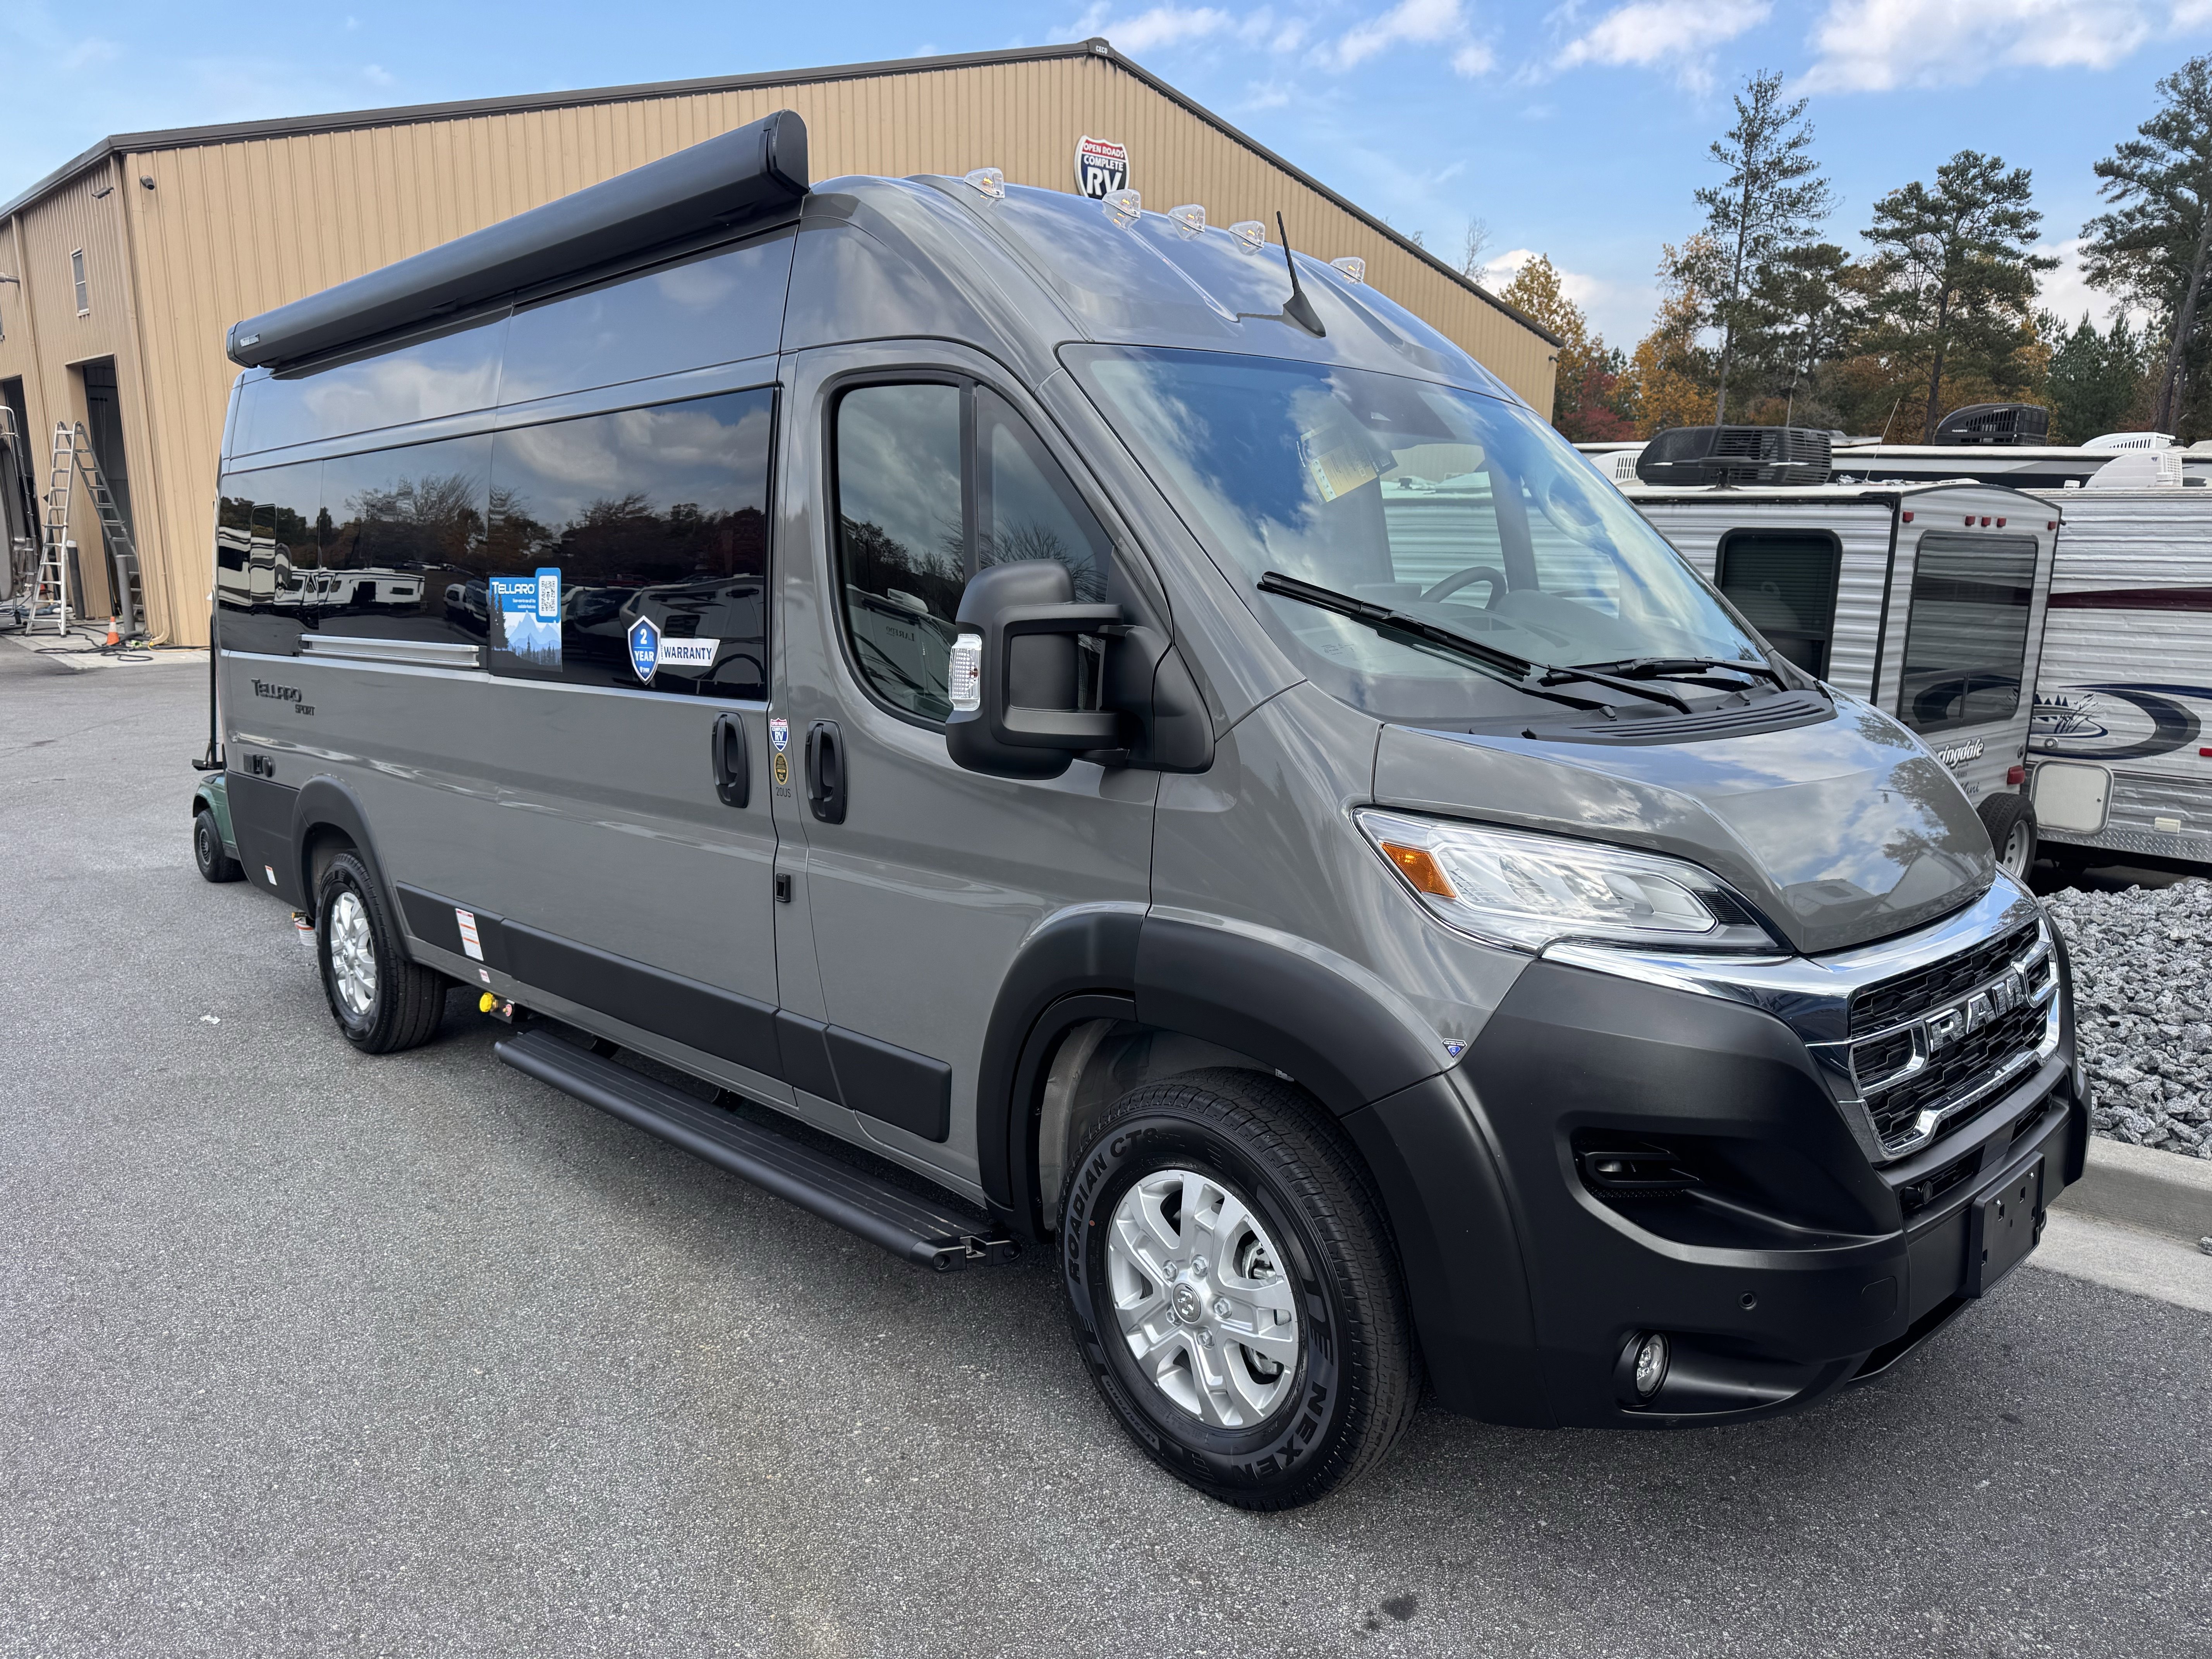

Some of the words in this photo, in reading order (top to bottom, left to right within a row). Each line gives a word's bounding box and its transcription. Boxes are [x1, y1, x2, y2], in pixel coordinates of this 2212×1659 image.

[1084, 143, 1102, 153] OPEN
[1102, 147, 1124, 158] ROADS
[1084, 155, 1124, 172] COMPLETE
[1087, 166, 1122, 196] RV
[492, 582, 535, 594] TELLARO
[640, 629, 647, 644] 2
[634, 650, 654, 662] YEAR
[663, 646, 712, 660] WARRANTY
[251, 678, 302, 703] TELLARO
[295, 704, 316, 716] SPORT
[775, 731, 784, 741] RV
[1926, 974, 2024, 1053] RAM
[1068, 1152, 1108, 1285] ROADIAN
[1110, 1128, 1159, 1158] CT8
[1231, 1381, 1327, 1480] NEXEN
